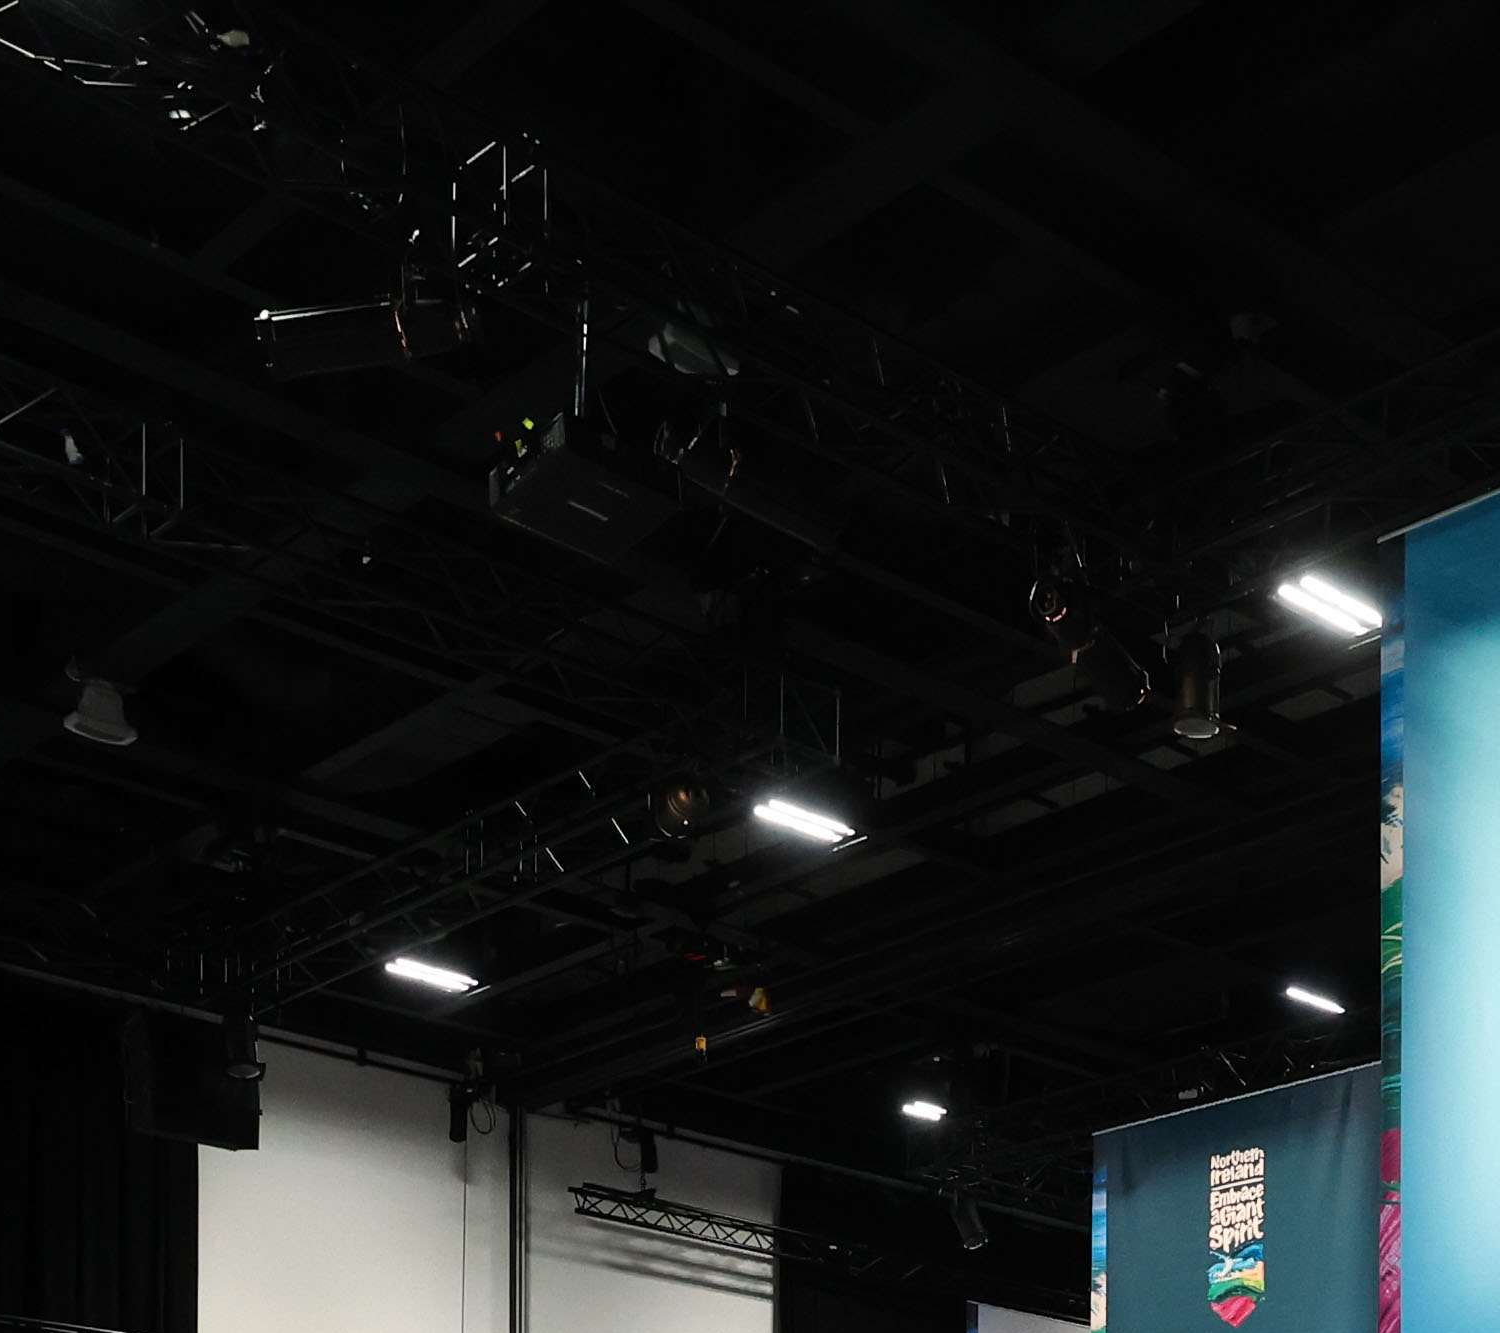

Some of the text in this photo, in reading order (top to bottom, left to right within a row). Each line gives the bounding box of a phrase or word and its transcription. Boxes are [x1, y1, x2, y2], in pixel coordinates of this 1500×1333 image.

[1210, 1147, 1265, 1170] Northern
[1210, 1158, 1264, 1185] Ireland
[1210, 1184, 1264, 1210] Embrace
[1209, 1216, 1265, 1253] Spirit
